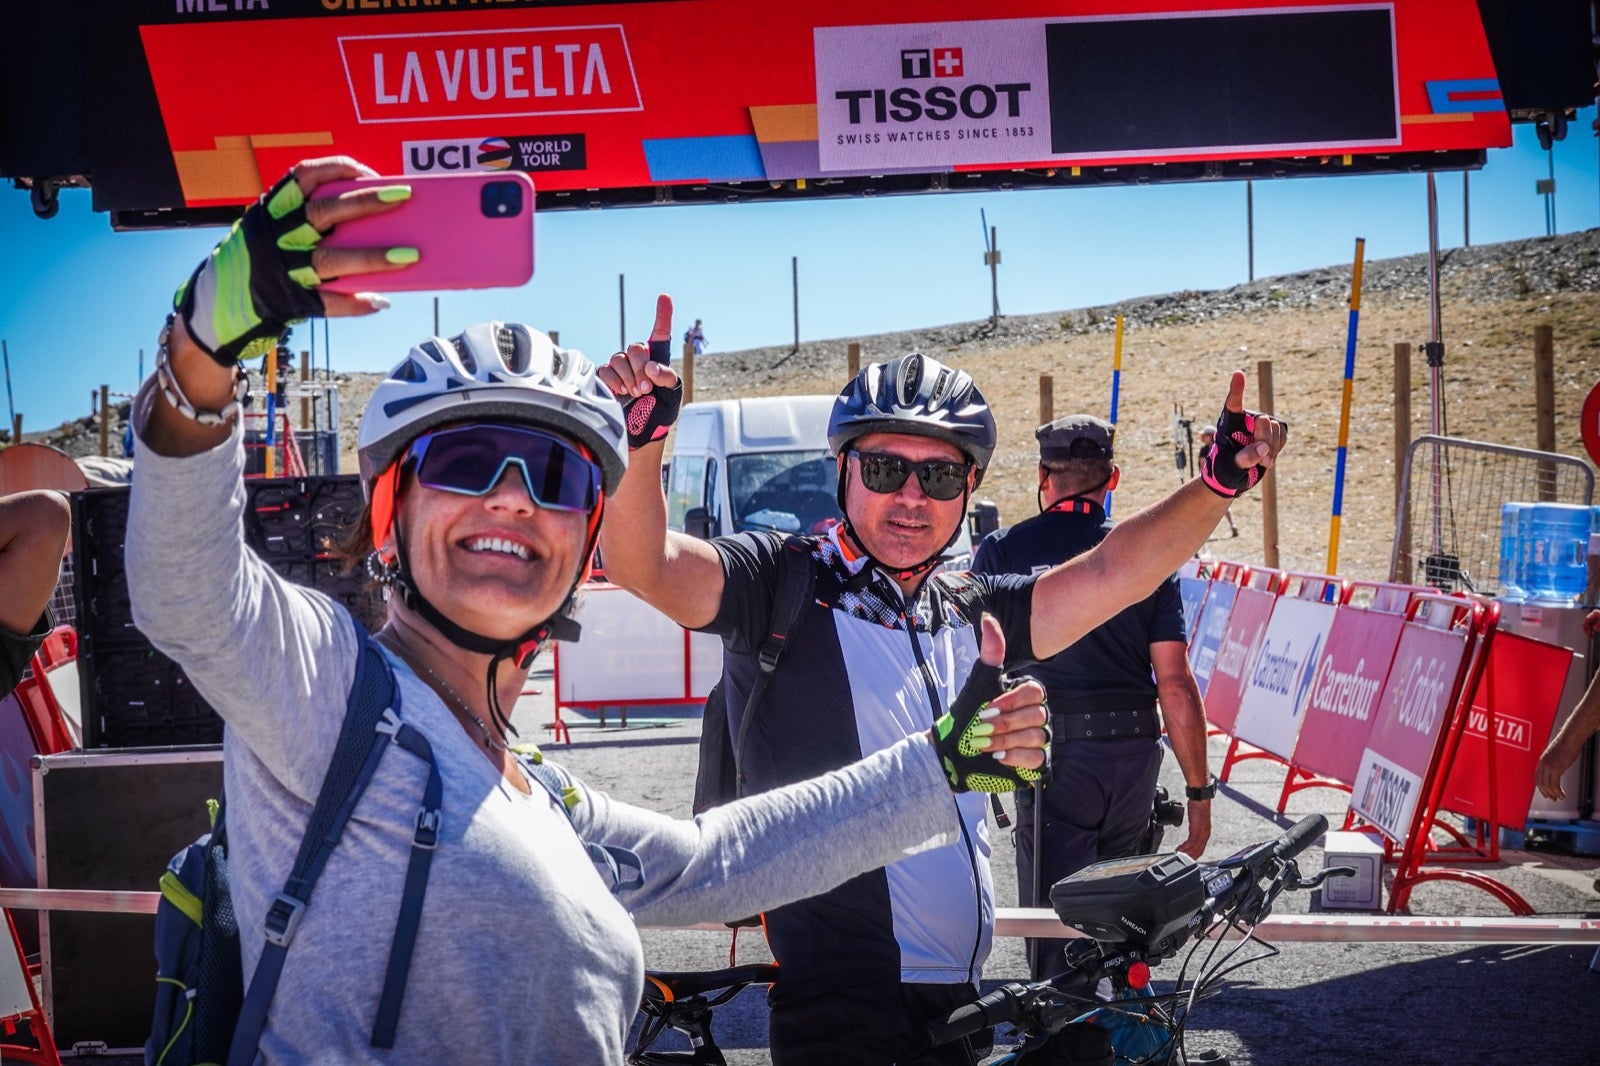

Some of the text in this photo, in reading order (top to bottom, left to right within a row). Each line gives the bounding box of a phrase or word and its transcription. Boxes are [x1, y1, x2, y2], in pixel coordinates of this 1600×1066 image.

[373, 43, 612, 104] LA VUELTA
[835, 82, 1031, 124] TISSOT
[836, 126, 1035, 145] SWISS WATCHES SINCE 1853
[410, 140, 572, 171] UCI WORLD
[521, 154, 561, 167] TOUR
[1312, 653, 1380, 721] Carrefour
